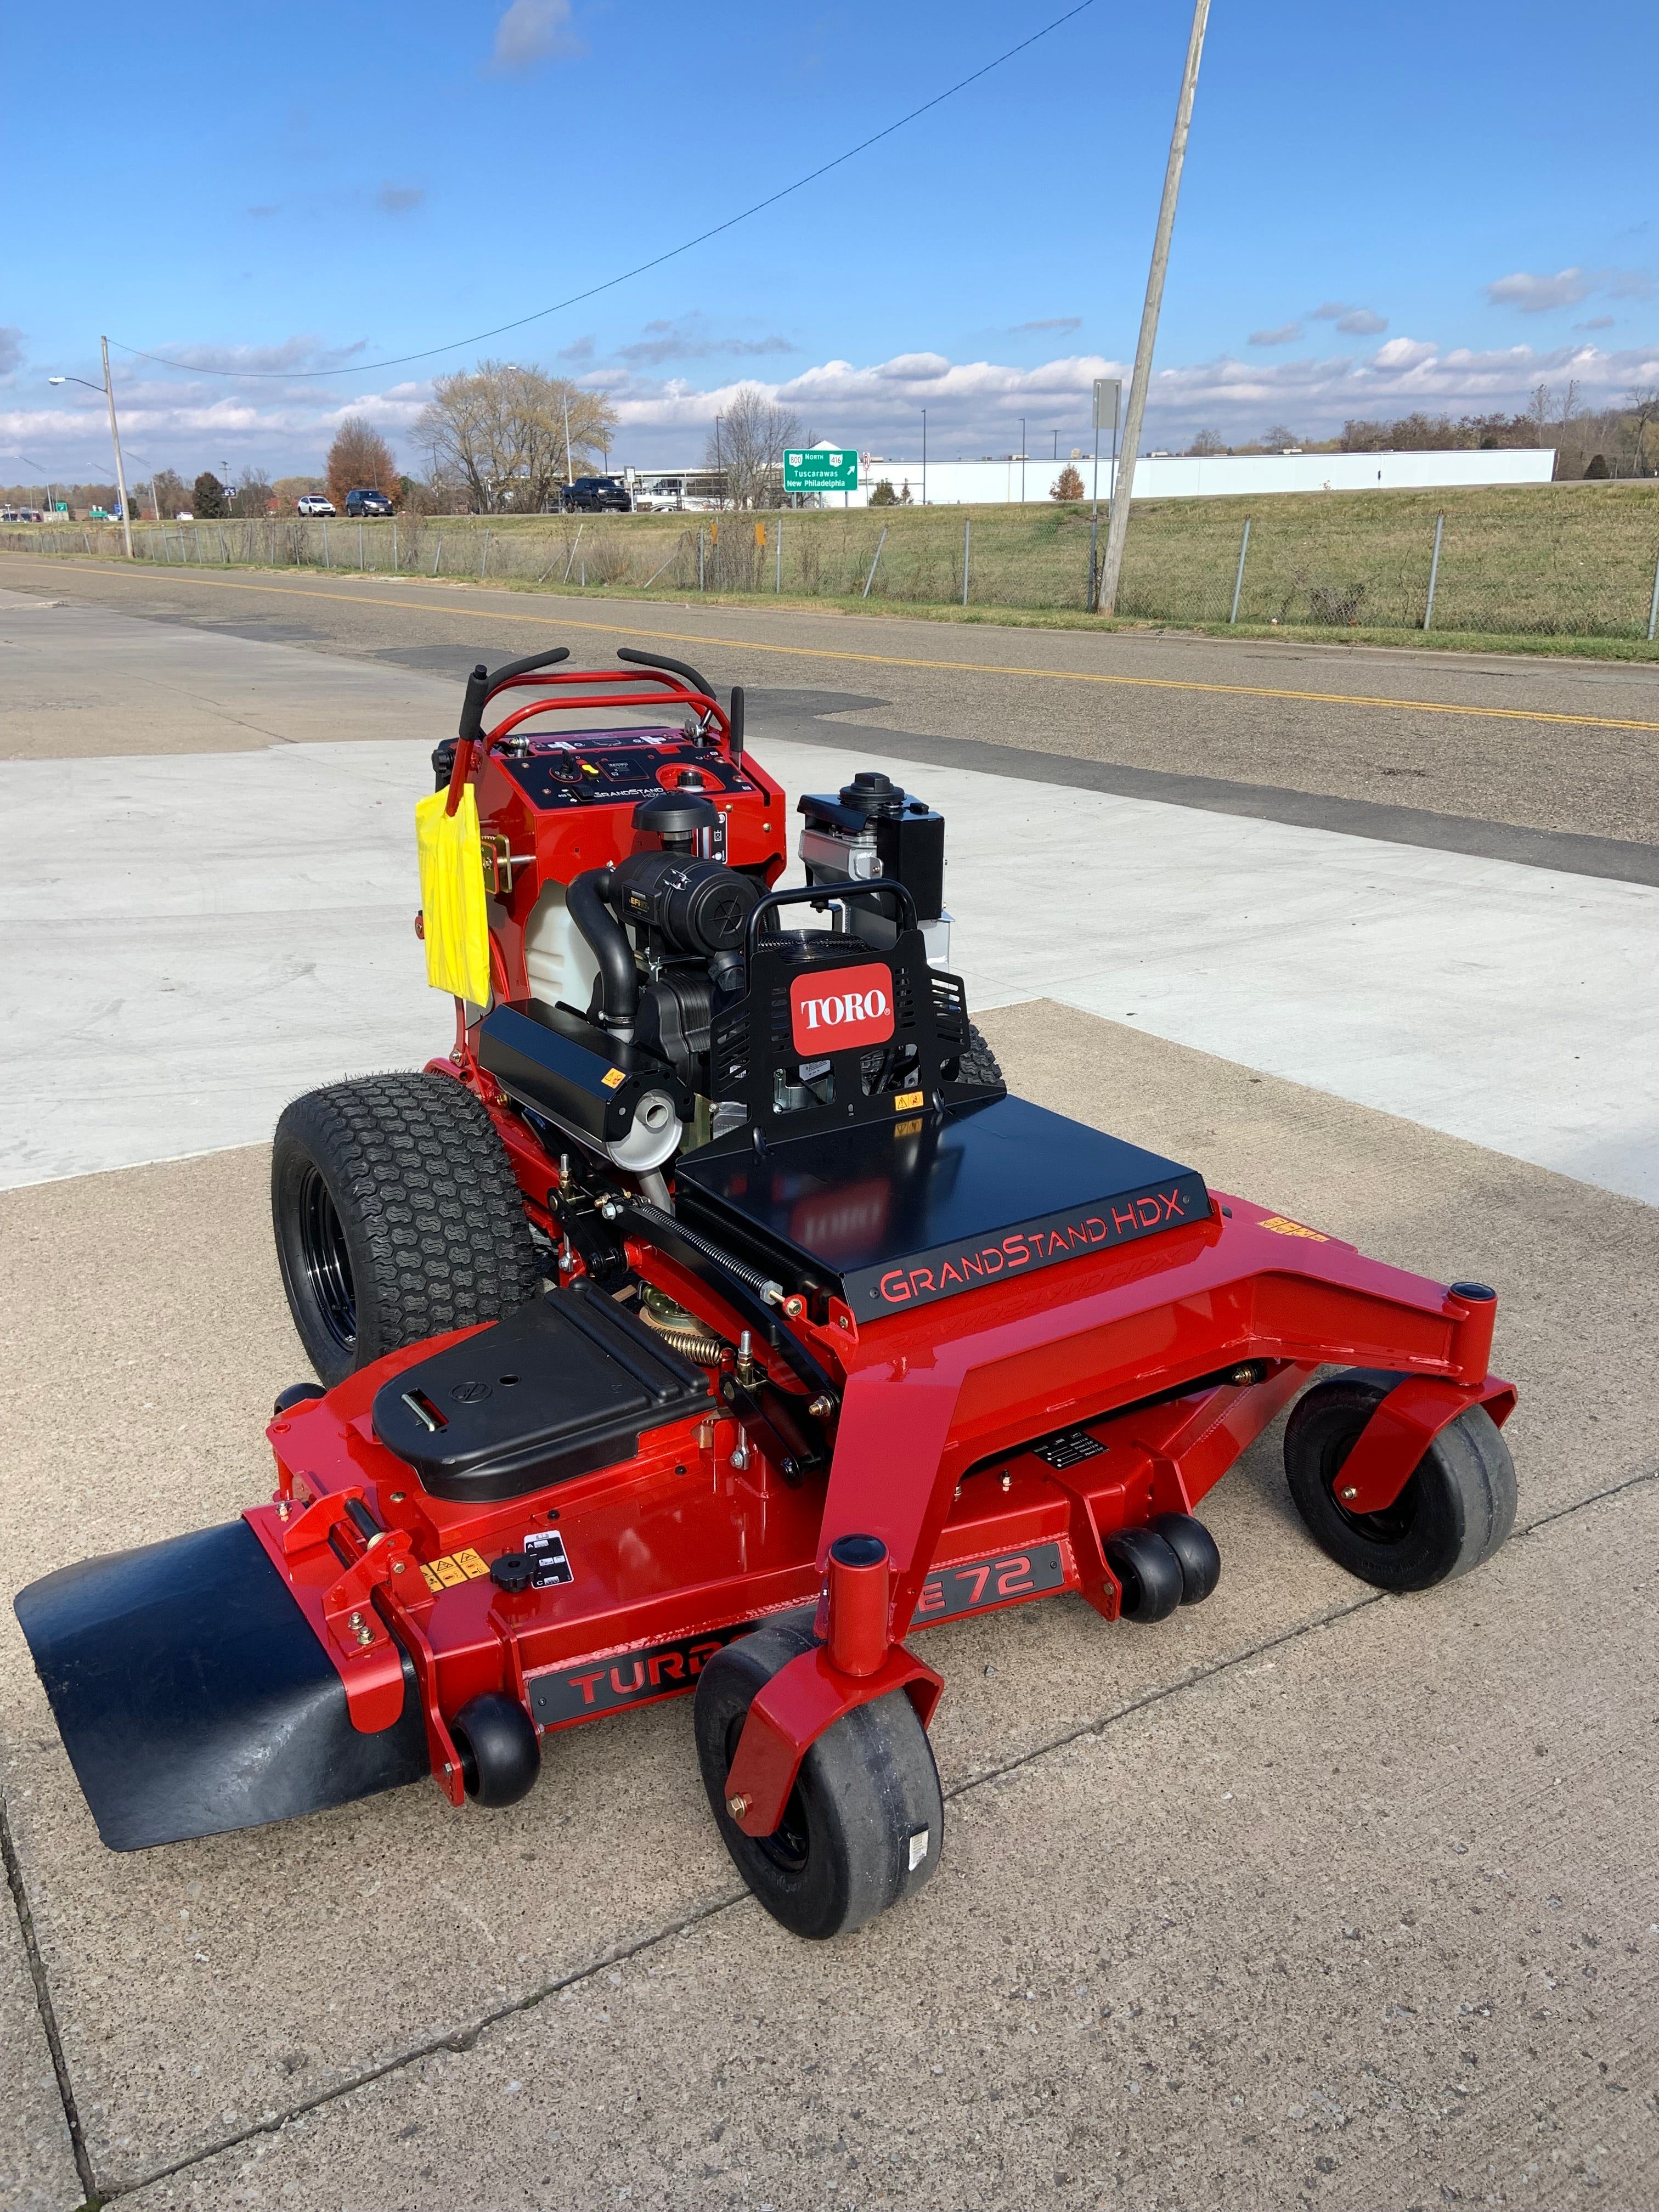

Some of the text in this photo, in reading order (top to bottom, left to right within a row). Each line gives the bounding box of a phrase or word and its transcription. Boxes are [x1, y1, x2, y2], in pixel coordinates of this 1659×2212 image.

[804, 479, 845, 488] Philadelphia
[879, 1189, 1186, 1303] GRANDSTAND HDX
[955, 1556, 1035, 1605] 72
